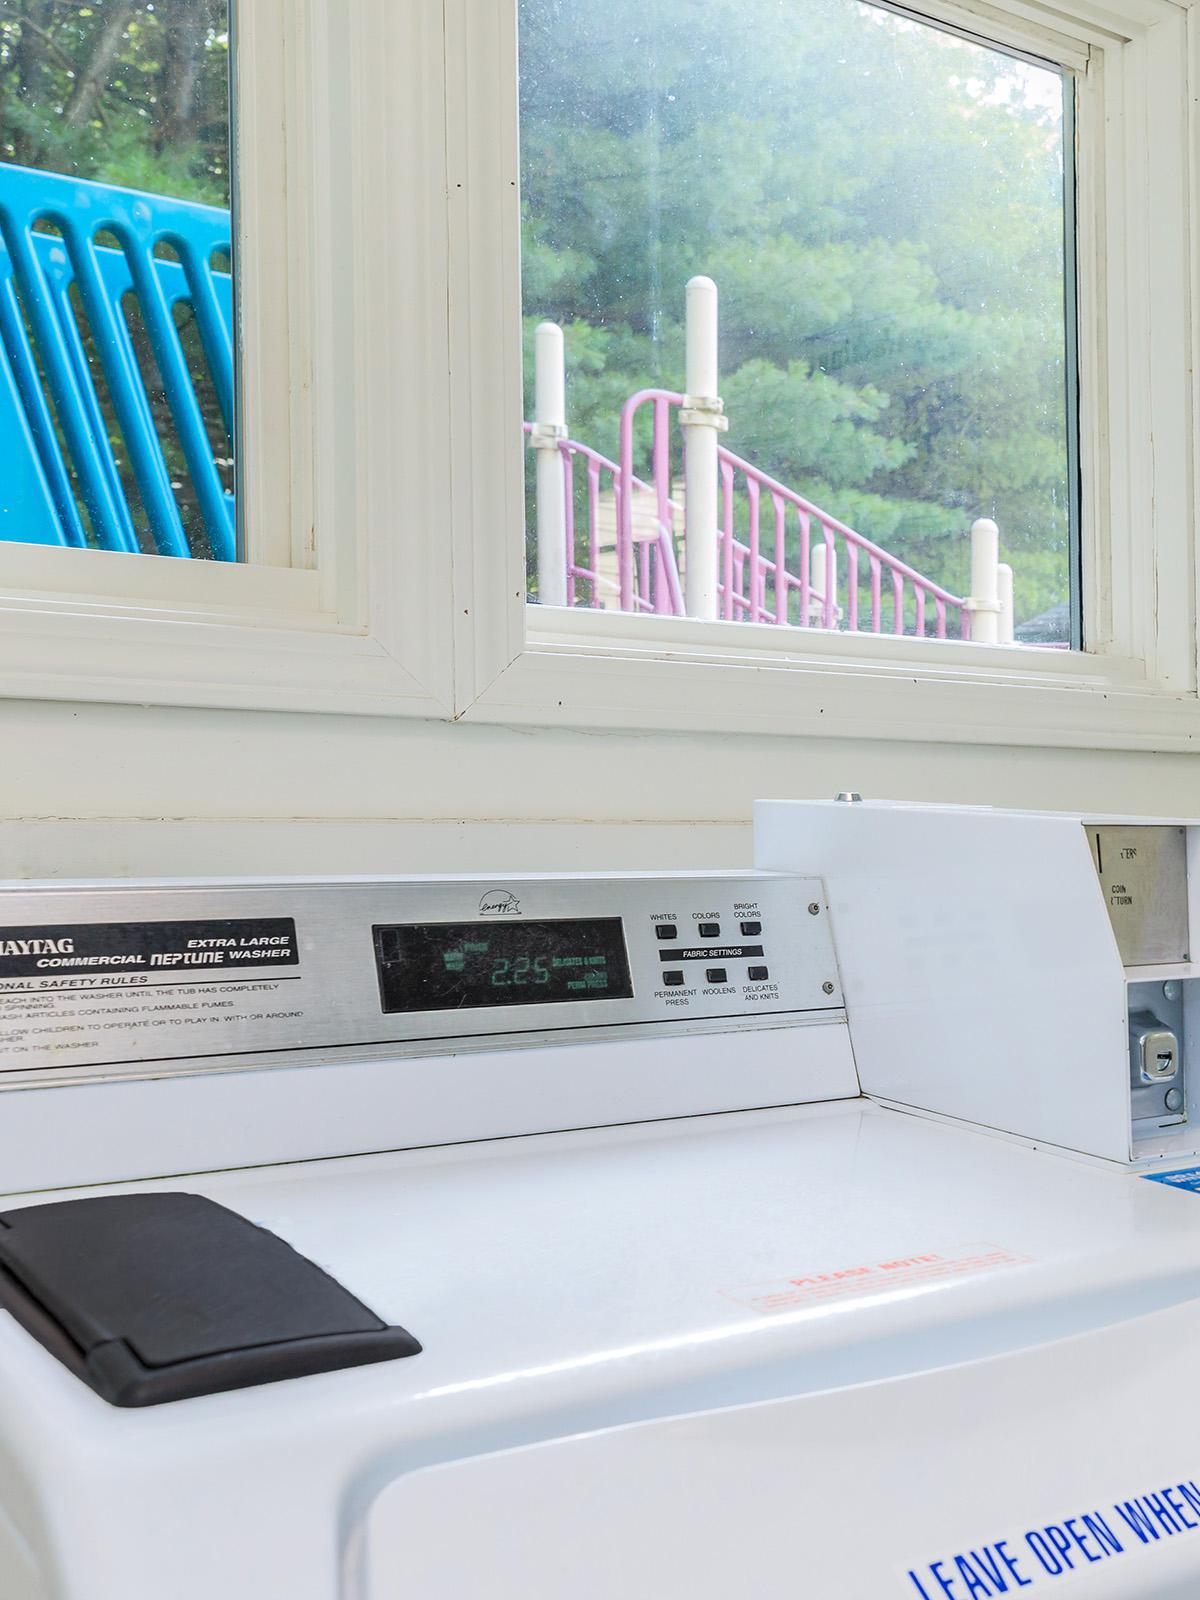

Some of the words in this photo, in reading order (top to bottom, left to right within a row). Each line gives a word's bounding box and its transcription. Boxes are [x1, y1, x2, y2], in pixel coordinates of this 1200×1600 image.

[187, 938, 237, 949] EXTRA
[240, 935, 290, 948] LARGE
[36, 955, 147, 968] COMMERCIAL
[228, 948, 291, 960] WASHER
[683, 950, 708, 958] FABRIC
[709, 949, 742, 957] SETTINGS
[40, 978, 97, 989] SAFETY
[100, 976, 148, 985] RULES
[80, 992, 123, 1000] WASHER
[125, 990, 152, 998] UNTIL
[219, 984, 279, 993] COMPLETELY
[702, 987, 736, 995] WOOLENS
[742, 984, 778, 993] DELICATES
[654, 989, 697, 998] PERMANENT
[665, 998, 689, 1006] PRESS
[78, 1007, 139, 1016] CONTAINING
[908, 1541, 1032, 1600] LEAVE
[1025, 1511, 1124, 1576] OPEN
